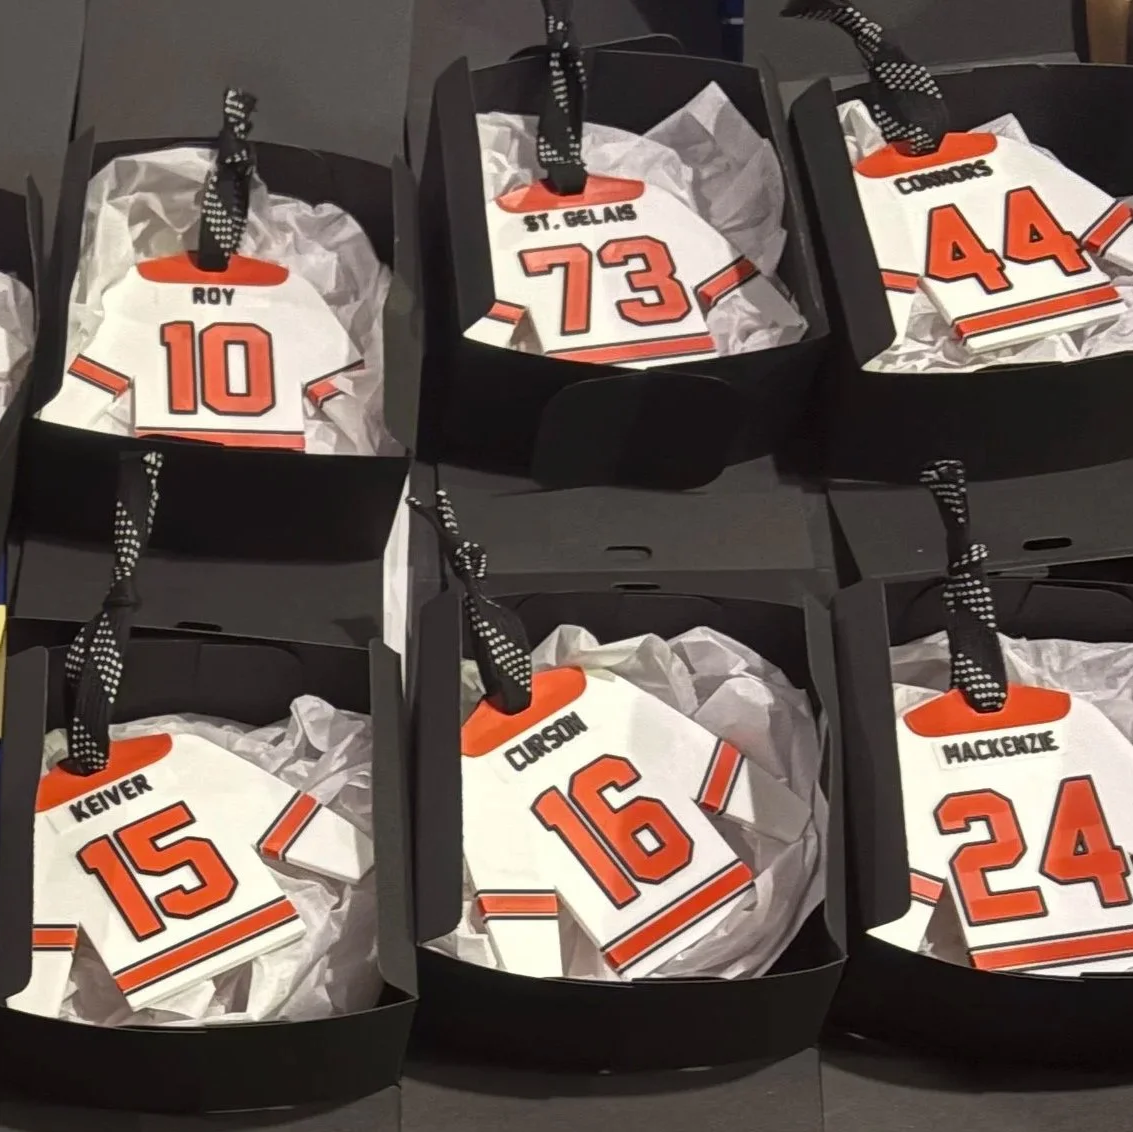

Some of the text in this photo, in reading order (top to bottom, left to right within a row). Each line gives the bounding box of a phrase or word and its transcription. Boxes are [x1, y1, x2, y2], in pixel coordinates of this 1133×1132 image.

[895, 160, 994, 197] CONNORS
[524, 203, 637, 232] ST. GELAIS
[925, 186, 1091, 294] 44
[192, 286, 235, 305] ROY
[518, 234, 692, 334] 73
[160, 320, 275, 415] 10
[505, 712, 588, 771] CURSON
[941, 730, 1060, 765] MACKENZIE
[69, 774, 154, 823] KEIVER
[531, 754, 694, 909] 16
[76, 800, 238, 940] 15
[934, 774, 1133, 925] 24
